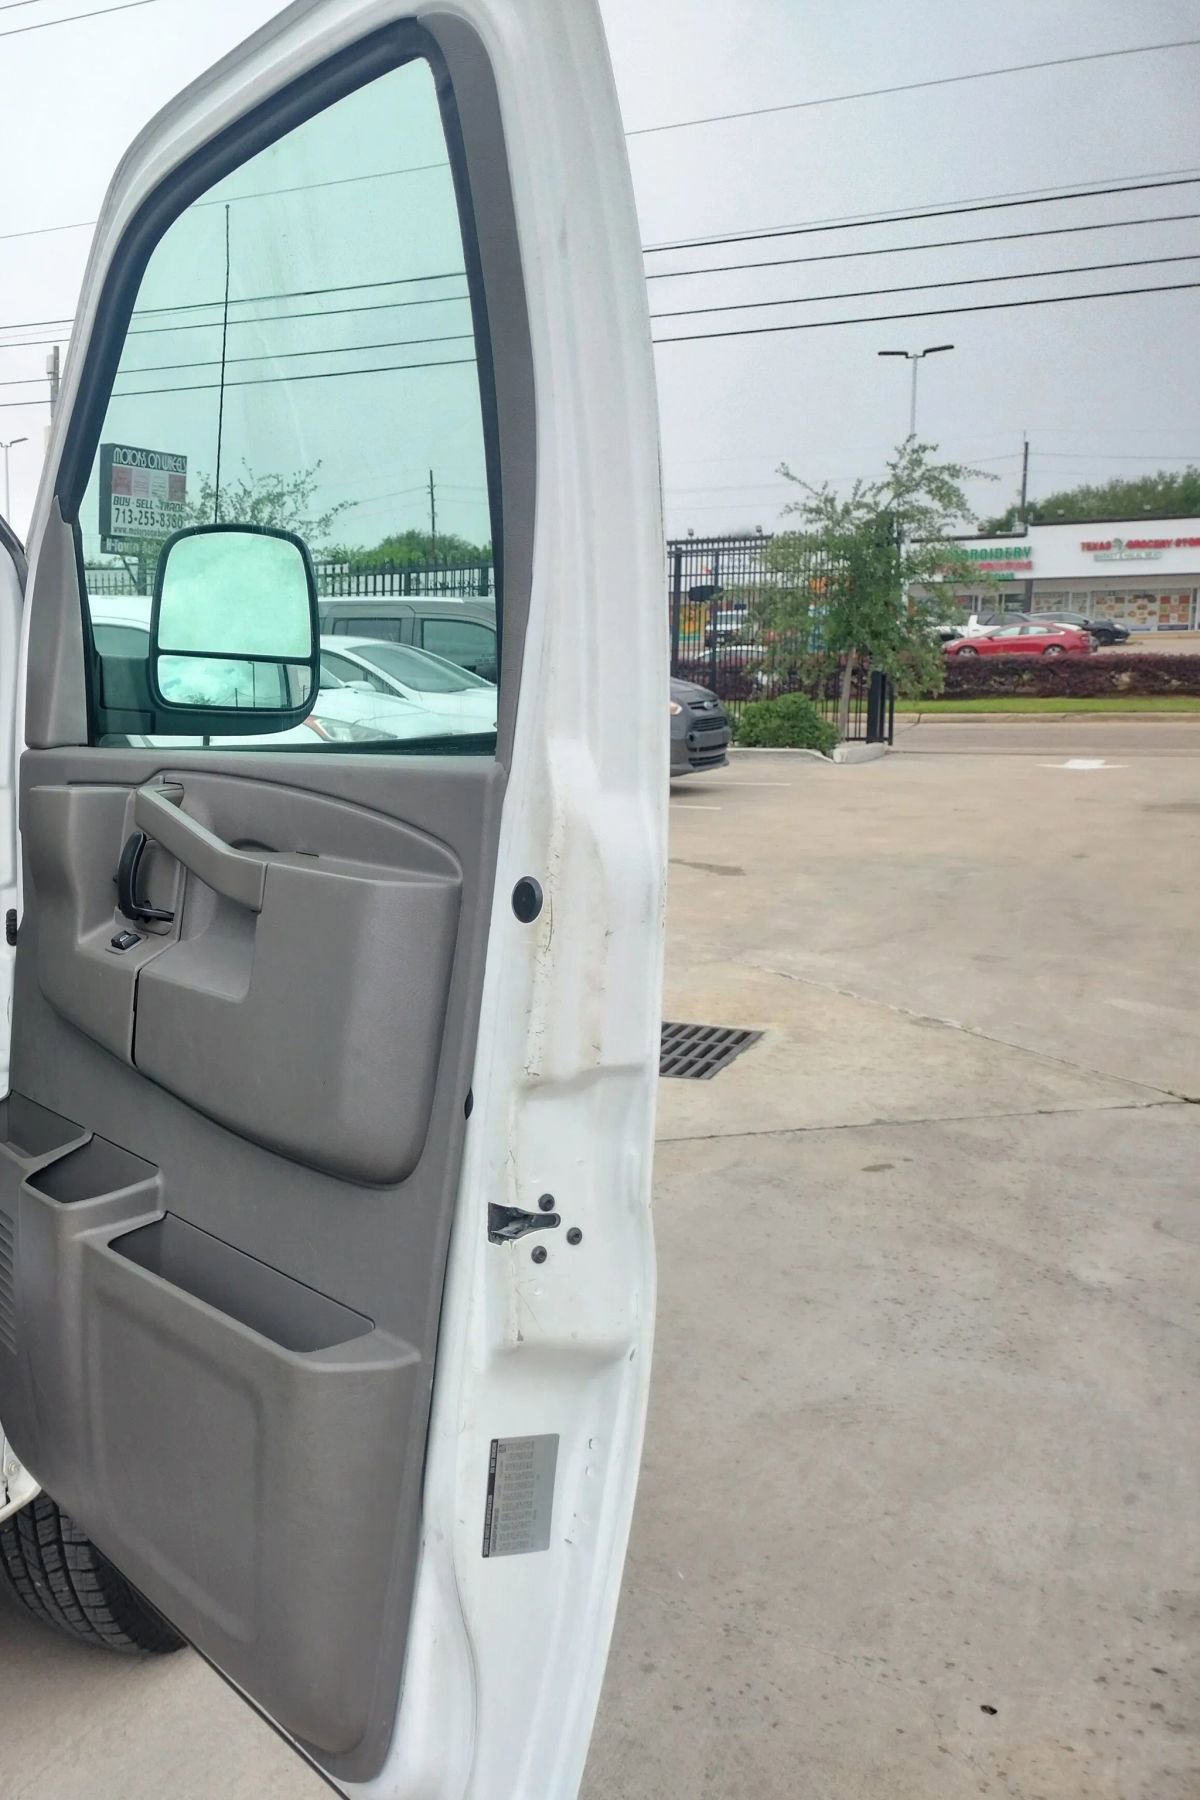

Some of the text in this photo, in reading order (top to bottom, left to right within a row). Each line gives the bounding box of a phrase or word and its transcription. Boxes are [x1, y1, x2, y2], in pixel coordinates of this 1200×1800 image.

[113, 447, 147, 468] MOTORS
[148, 453, 161, 470] ON
[113, 496, 185, 513] BUY SELL TRADE
